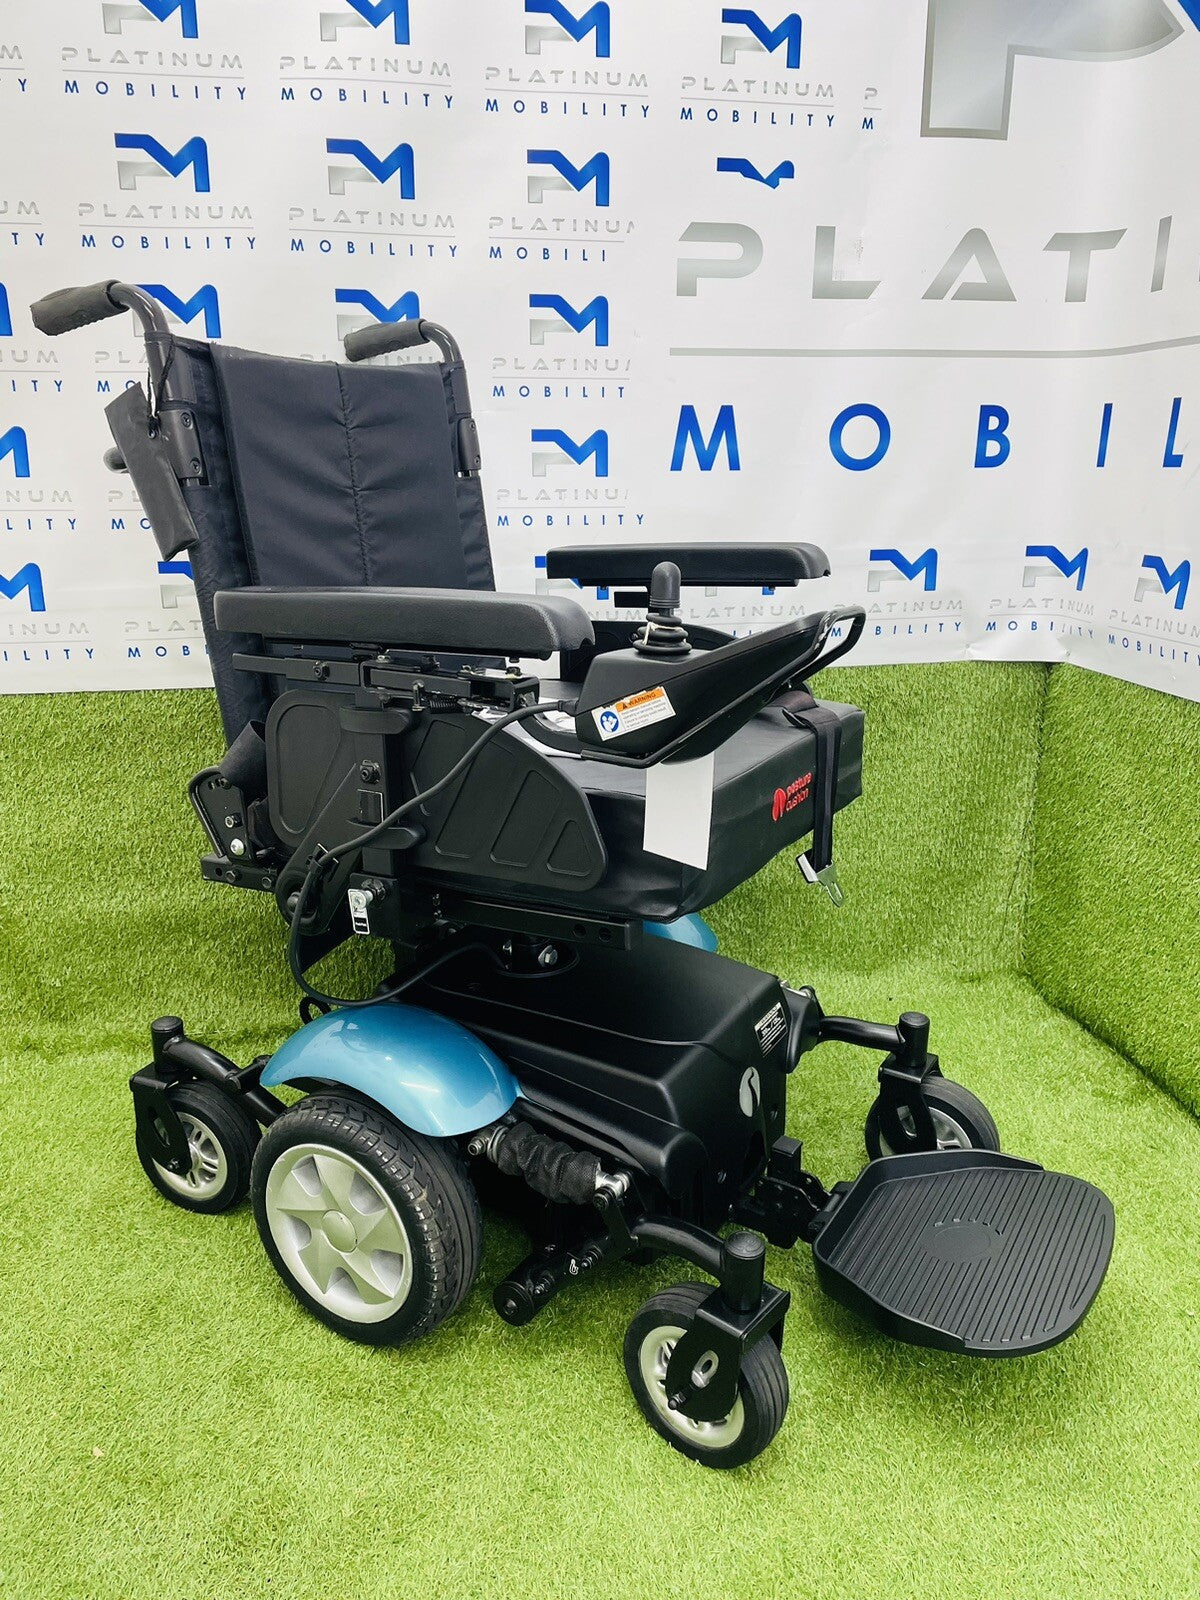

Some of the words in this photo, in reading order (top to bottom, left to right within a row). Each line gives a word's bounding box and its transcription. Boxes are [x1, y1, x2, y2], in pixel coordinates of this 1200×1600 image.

[61, 46, 243, 70] PLATINUM
[279, 56, 451, 77] PLATINUM
[484, 66, 649, 88] PLATINUM
[65, 80, 245, 100] MOBILITY
[681, 76, 834, 98] PLATINUM
[281, 88, 452, 108] MOBILITY
[486, 99, 649, 118] MOBILITY
[680, 107, 834, 127] MOBILITY
[78, 202, 253, 221] PLATINUM
[288, 207, 456, 228] PLATINUM
[82, 235, 255, 249] MOBILITY
[291, 239, 457, 257] MOBILITY
[490, 247, 605, 261] MOBILI
[493, 386, 624, 397] MOBILIT
[497, 488, 629, 500] PLATINU
[498, 514, 643, 526] MOBILITY
[990, 597, 1095, 615] PLATINUM
[831, 622, 962, 637] MBILITY
[986, 620, 1094, 640] MOBILITY
